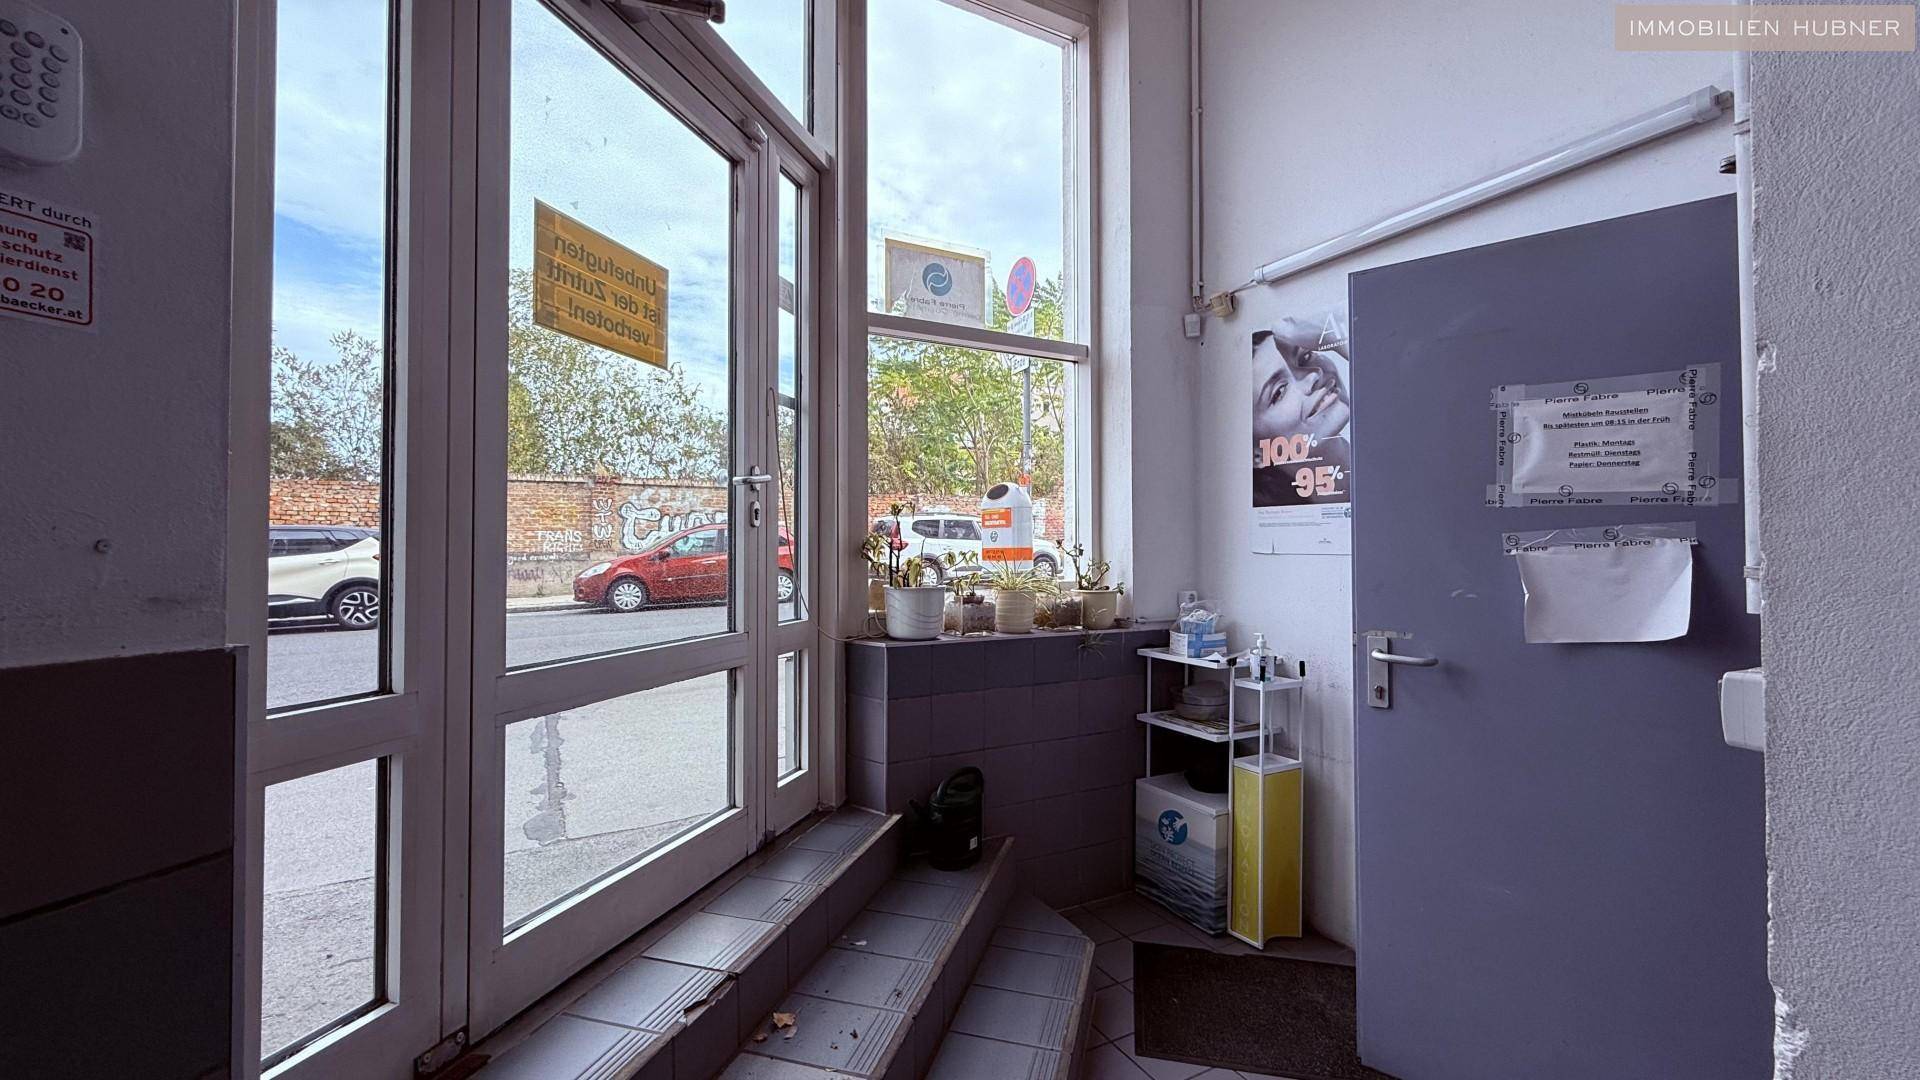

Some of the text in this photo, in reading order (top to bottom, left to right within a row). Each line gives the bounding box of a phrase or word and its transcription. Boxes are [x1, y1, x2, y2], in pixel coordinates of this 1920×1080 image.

[42, 206, 92, 229] durch
[30, 283, 64, 302] 20
[1646, 387, 1686, 396] Pierre
[1545, 393, 1619, 405] Pierre Fabre
[1688, 368, 1698, 431] Pierre Fabre
[1605, 407, 1649, 416] Rausstellen
[1499, 411, 1507, 466] Pierre Fabre
[1602, 439, 1635, 447] Montags
[1259, 433, 1318, 467] 100%
[1604, 449, 1641, 457] Dienstags
[1596, 460, 1641, 468] Donnerstag
[1688, 452, 1697, 481] Pierre
[1530, 496, 1603, 505] Pierre Fabre
[1630, 496, 1669, 504] Pierre
[536, 530, 583, 543] TRANS
[1574, 539, 1651, 550] Pierre Fabre
